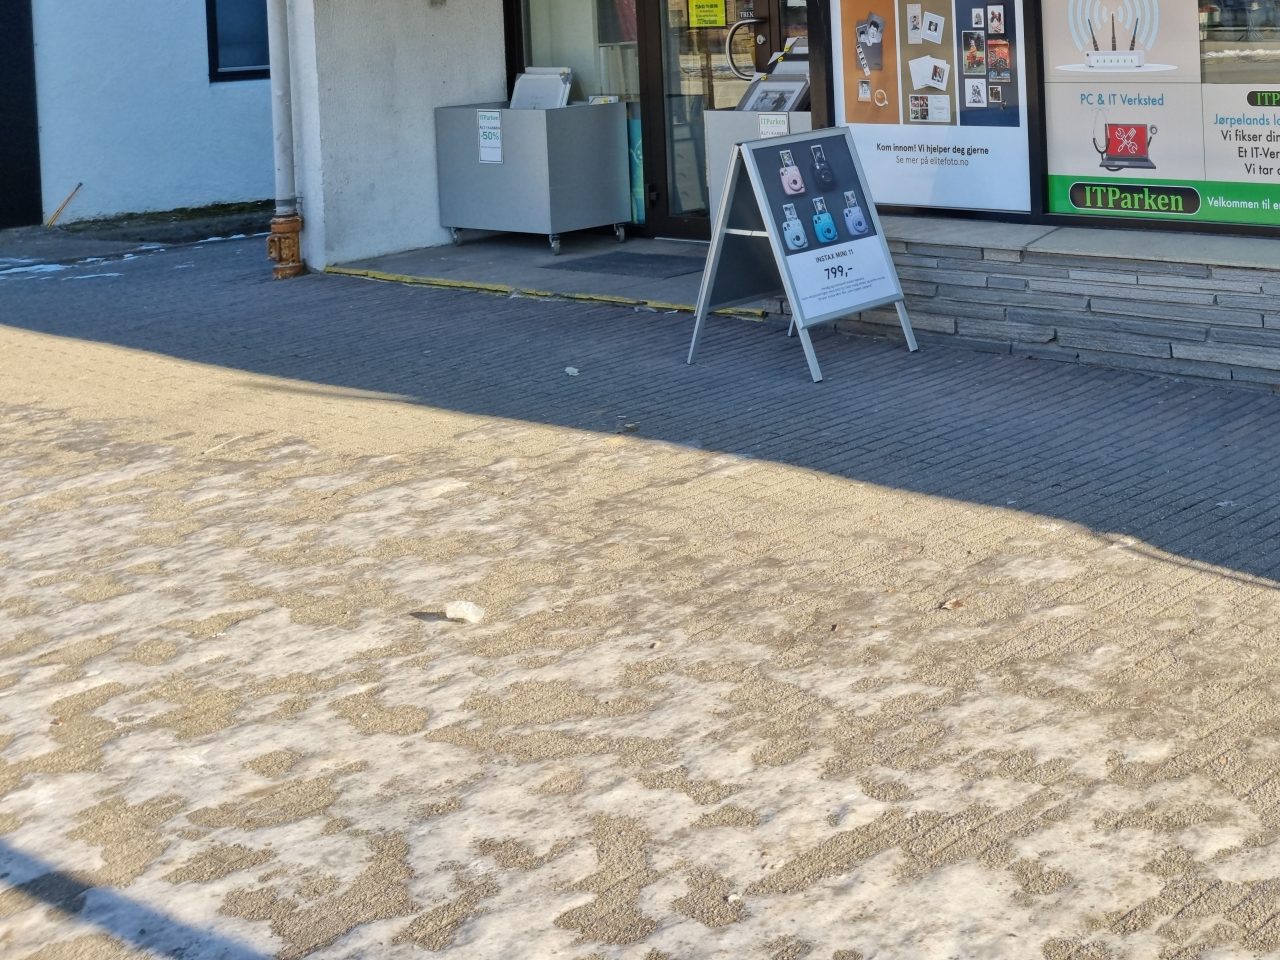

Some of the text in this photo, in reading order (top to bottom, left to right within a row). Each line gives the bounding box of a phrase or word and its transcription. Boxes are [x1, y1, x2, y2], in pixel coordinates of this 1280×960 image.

[1080, 93, 1164, 107] PC & IT Verksted
[1213, 112, 1271, 129] Jørpelands
[1221, 129, 1232, 142] Vi
[1235, 129, 1263, 143] fikser
[876, 143, 989, 157] Kom innom! Vi hjelper deg gjerne
[895, 155, 969, 167] Se mer på elitefoto.no
[1084, 185, 1184, 212] ITParken
[1207, 196, 1260, 210] Velkommen
[1261, 197, 1271, 210] til
[815, 253, 835, 264] INSTAX
[824, 265, 853, 281] 799,-
